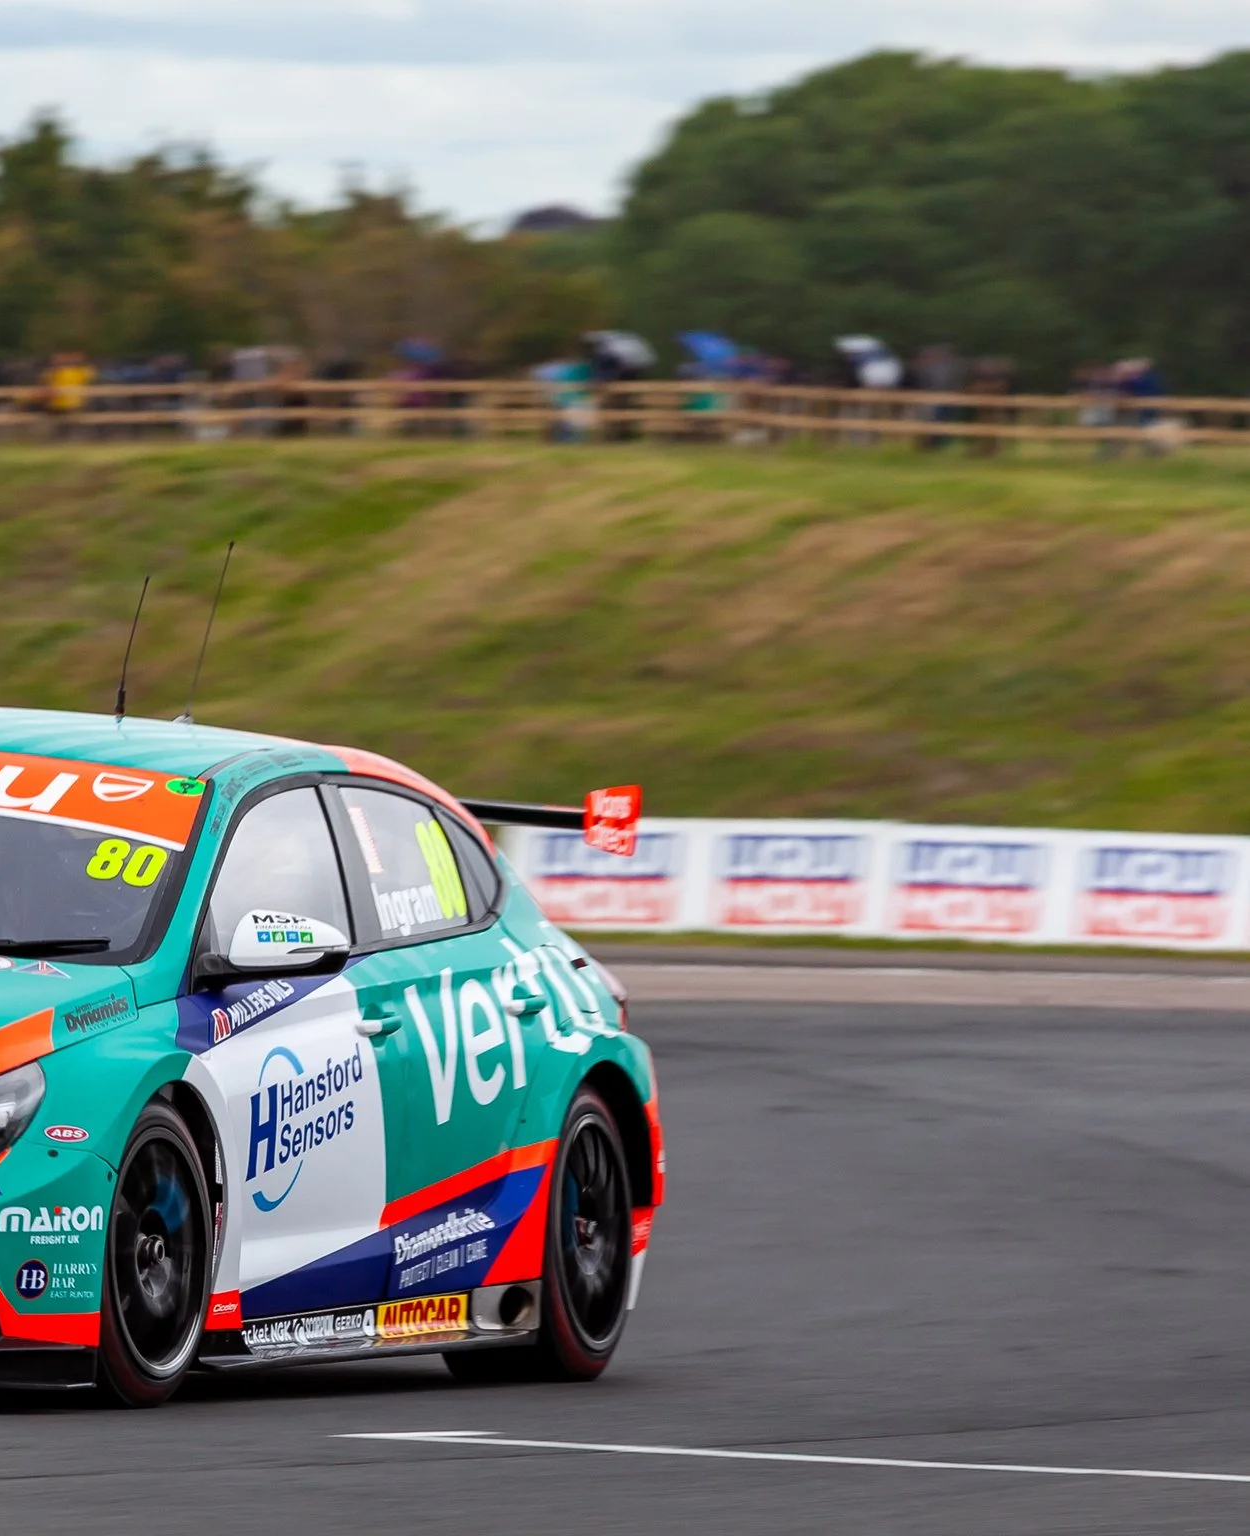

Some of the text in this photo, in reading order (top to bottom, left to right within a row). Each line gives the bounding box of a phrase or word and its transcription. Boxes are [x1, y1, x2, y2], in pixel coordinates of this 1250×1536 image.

[85, 838, 168, 888] 80
[371, 882, 443, 937] Ingram
[227, 979, 295, 1030] MILLERS OILS
[280, 1042, 363, 1116] Hansford
[50, 1128, 85, 1138] ABS
[278, 1101, 355, 1165] Sensors
[30, 1235, 80, 1245] FREIGHT UK
[51, 1276, 76, 1289] BAR
[270, 1320, 292, 1343] NGK
[382, 1297, 463, 1335] AUTOCAR
